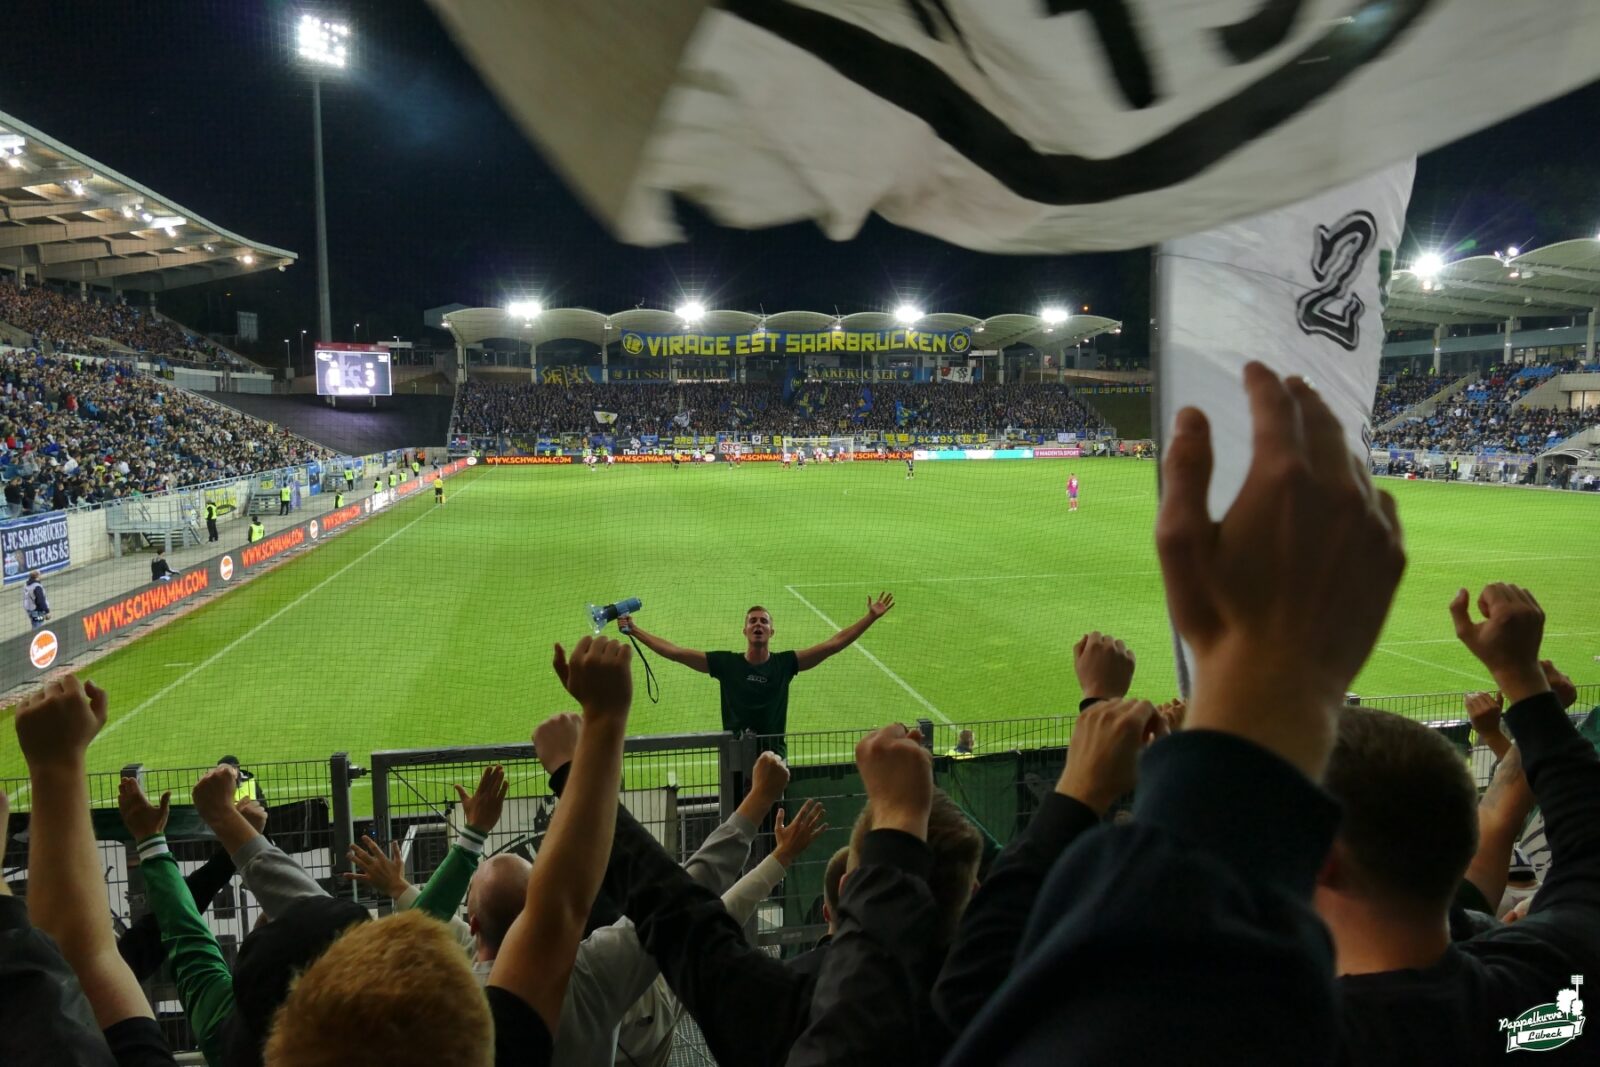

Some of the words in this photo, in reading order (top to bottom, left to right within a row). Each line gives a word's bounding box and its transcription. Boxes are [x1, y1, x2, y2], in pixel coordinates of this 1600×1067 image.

[646, 334, 731, 357] VIRAGE
[735, 332, 781, 355] EST
[26, 544, 58, 569] ULTRAS
[83, 568, 208, 641] WWW.SCHWAMM.COM
